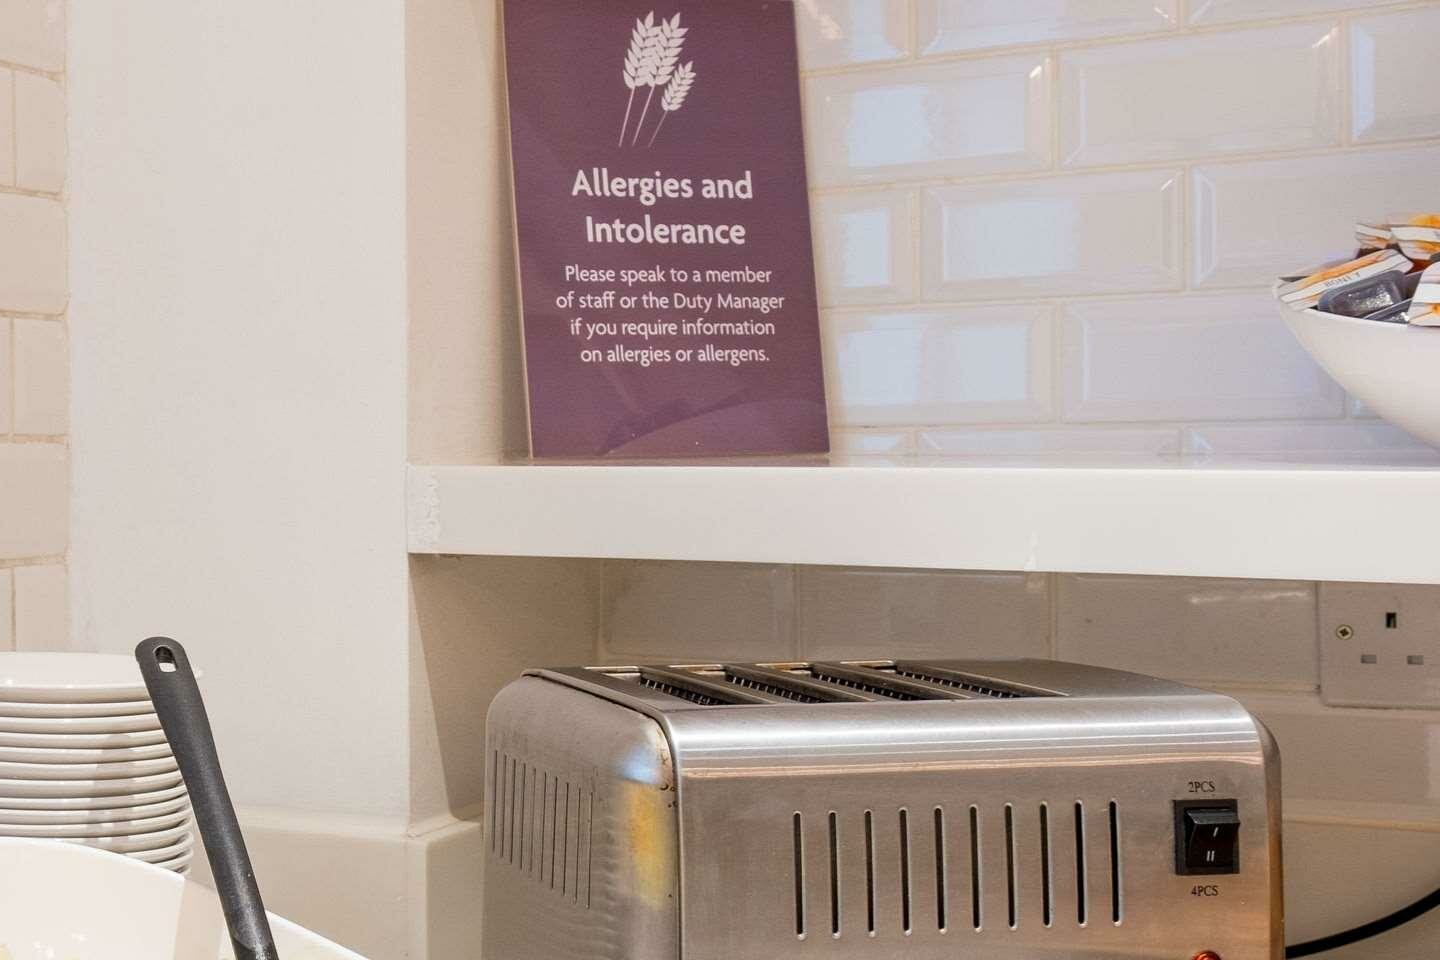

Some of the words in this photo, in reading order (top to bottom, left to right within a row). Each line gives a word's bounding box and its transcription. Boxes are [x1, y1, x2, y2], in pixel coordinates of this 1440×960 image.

[572, 167, 693, 206] Allergies
[702, 170, 753, 199] and
[586, 214, 746, 245] Intolerance
[565, 264, 615, 282] Please
[620, 265, 666, 286] speak
[670, 268, 688, 282] to
[692, 270, 702, 282] a
[706, 266, 772, 283] member
[556, 291, 574, 309] of
[579, 291, 616, 309] staff
[620, 295, 637, 309] or
[642, 292, 670, 309] the
[674, 293, 712, 313] Duty
[717, 293, 785, 314] Manager
[570, 317, 582, 335] if
[586, 321, 617, 340] you
[622, 319, 678, 340] require
[682, 318, 776, 335] information
[581, 349, 602, 362] on
[607, 345, 671, 367] allergies
[675, 349, 693, 362] or
[698, 345, 770, 366] allergens.
[1188, 781, 1216, 793] 2PCS
[1191, 885, 1219, 897] 4PCS
